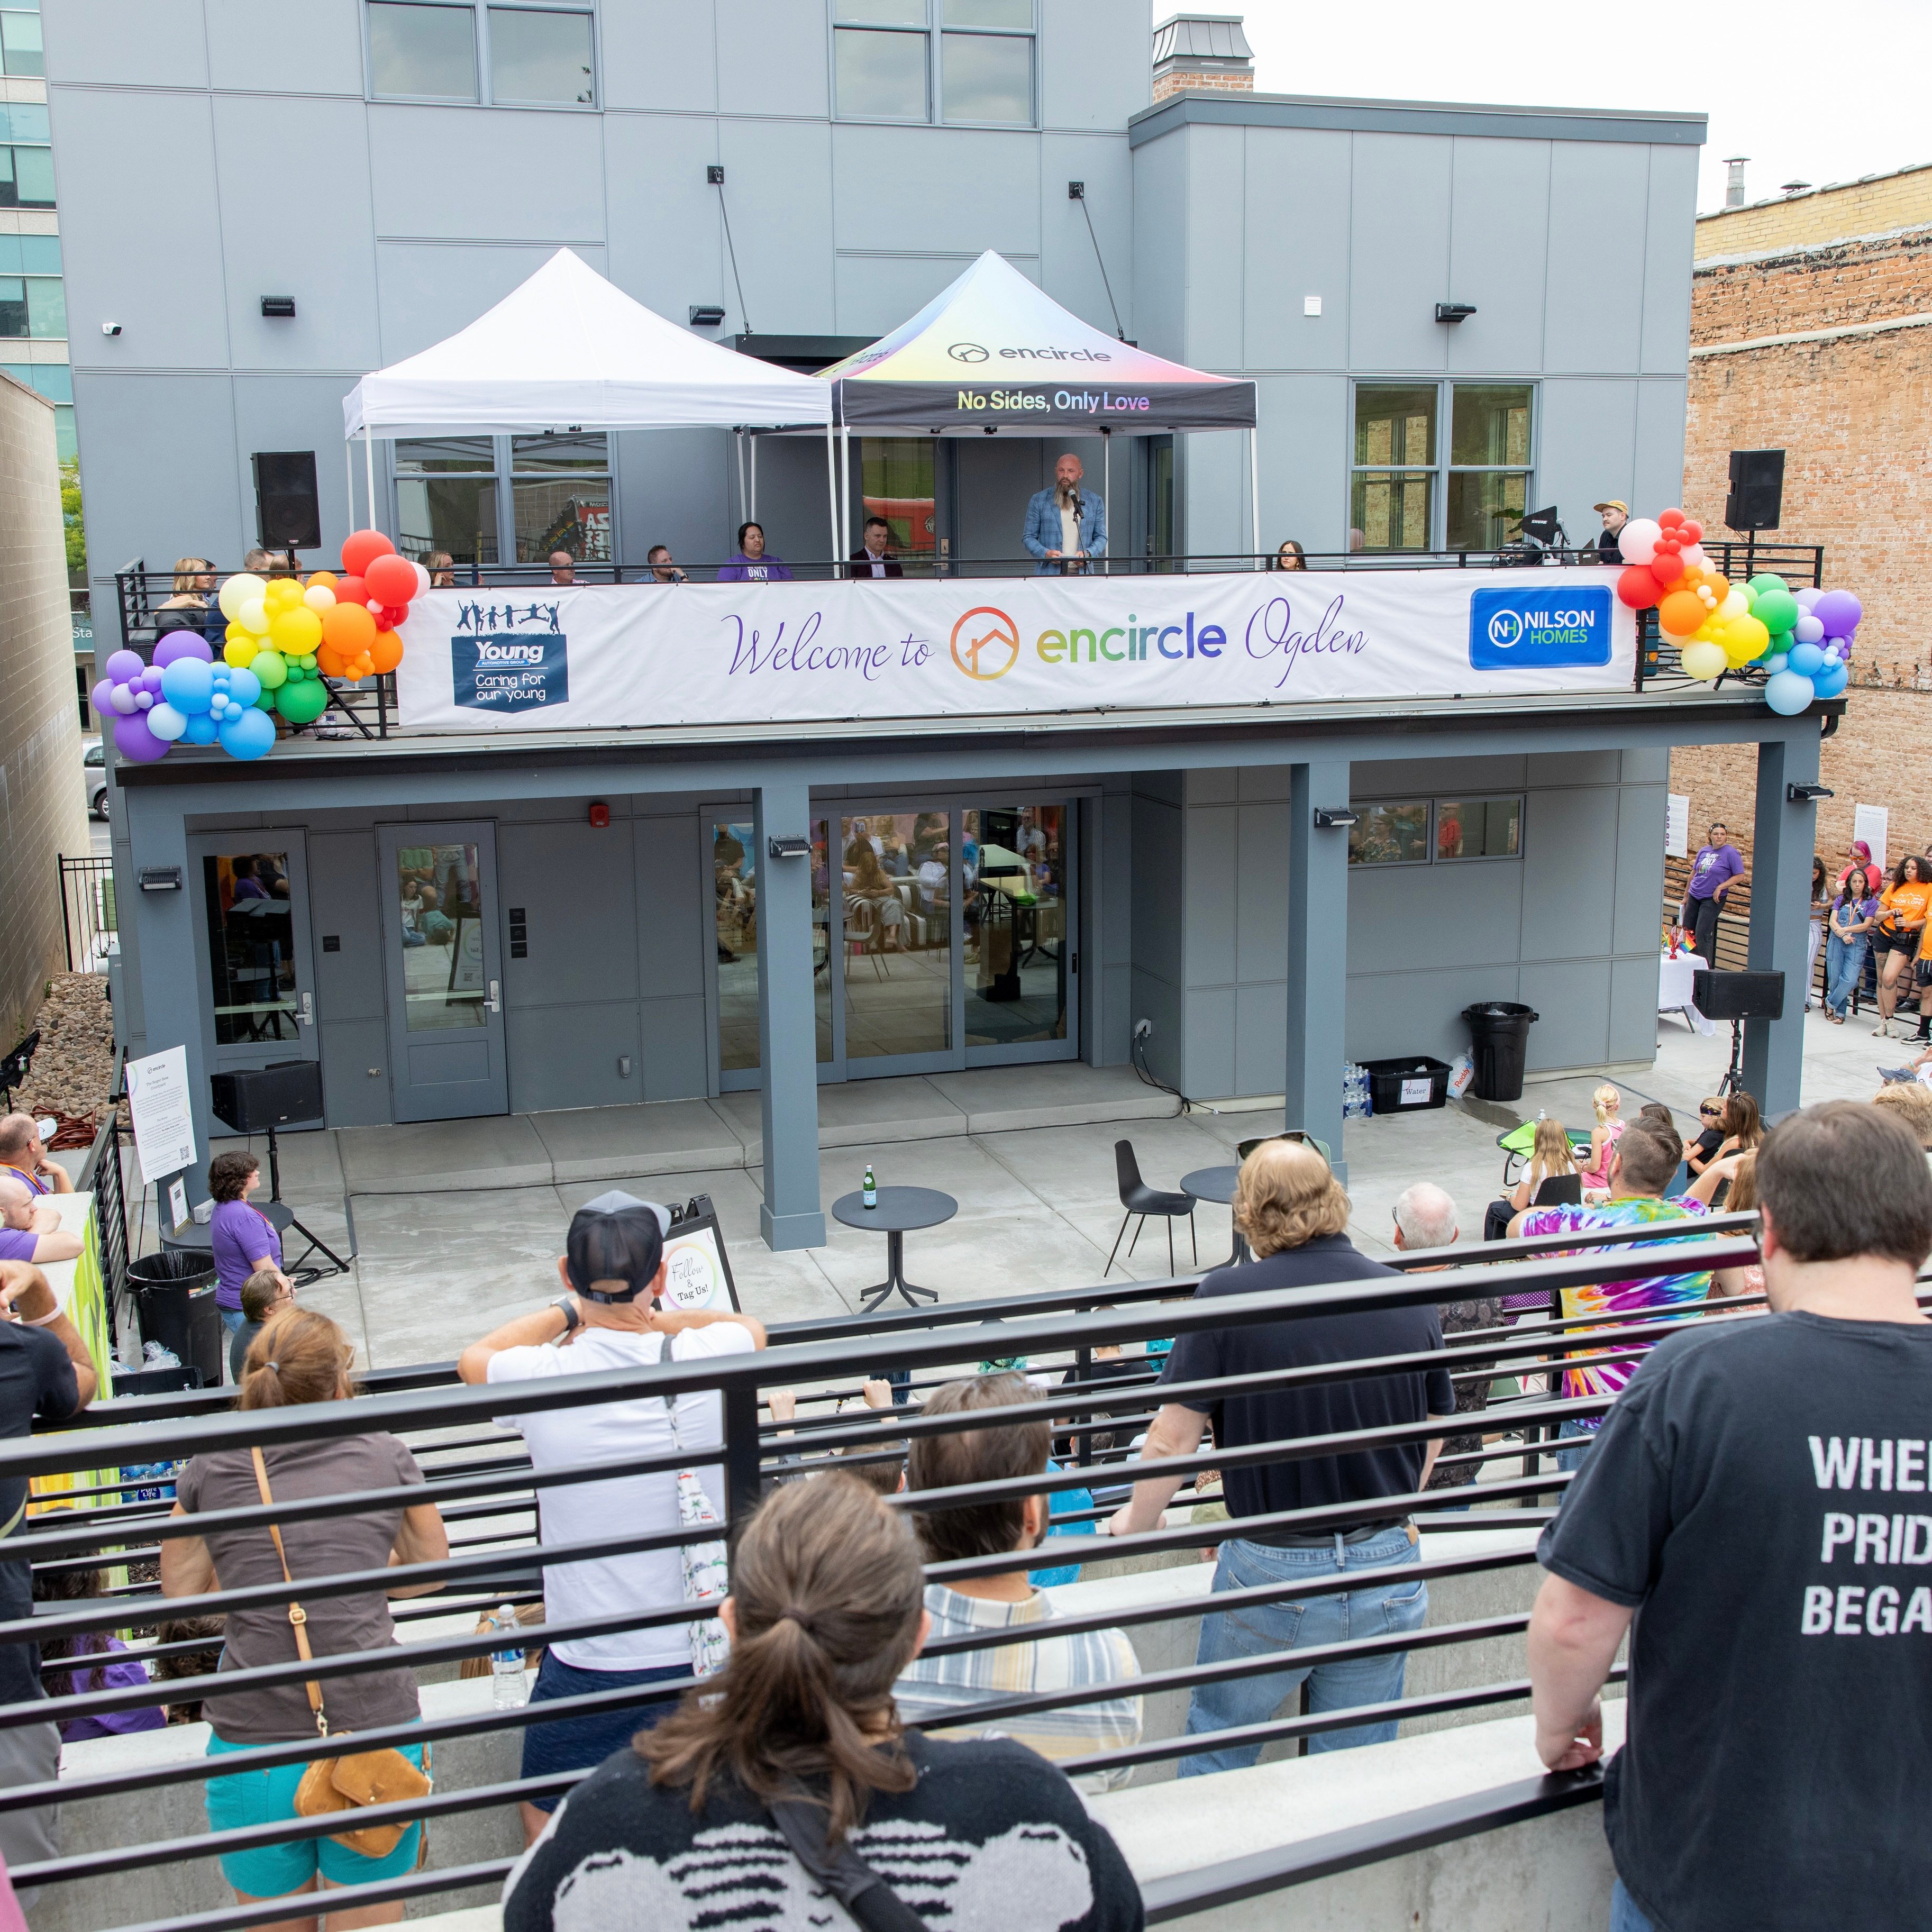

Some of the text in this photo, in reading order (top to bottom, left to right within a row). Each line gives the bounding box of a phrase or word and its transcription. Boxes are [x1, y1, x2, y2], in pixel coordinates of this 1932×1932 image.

[999, 347, 1111, 362] encircle
[958, 390, 1150, 413] No Sides, Only Love
[748, 569, 768, 578] ONLY
[1525, 610, 1594, 628] NILSON
[721, 595, 1370, 688] Welcome to encircle Ogden
[1530, 628, 1588, 644] HOMES
[475, 641, 544, 663] Young
[476, 673, 545, 688] Caring for
[477, 689, 546, 703] our young
[1701, 858, 1716, 866] ONLY
[671, 1257, 704, 1282] Follow
[687, 1279, 693, 1288] &
[677, 1284, 708, 1301] Tag Us!
[1807, 1435, 1932, 1492] WHE
[1821, 1512, 1932, 1565] PRID
[1801, 1585, 1932, 1636] BEGA
